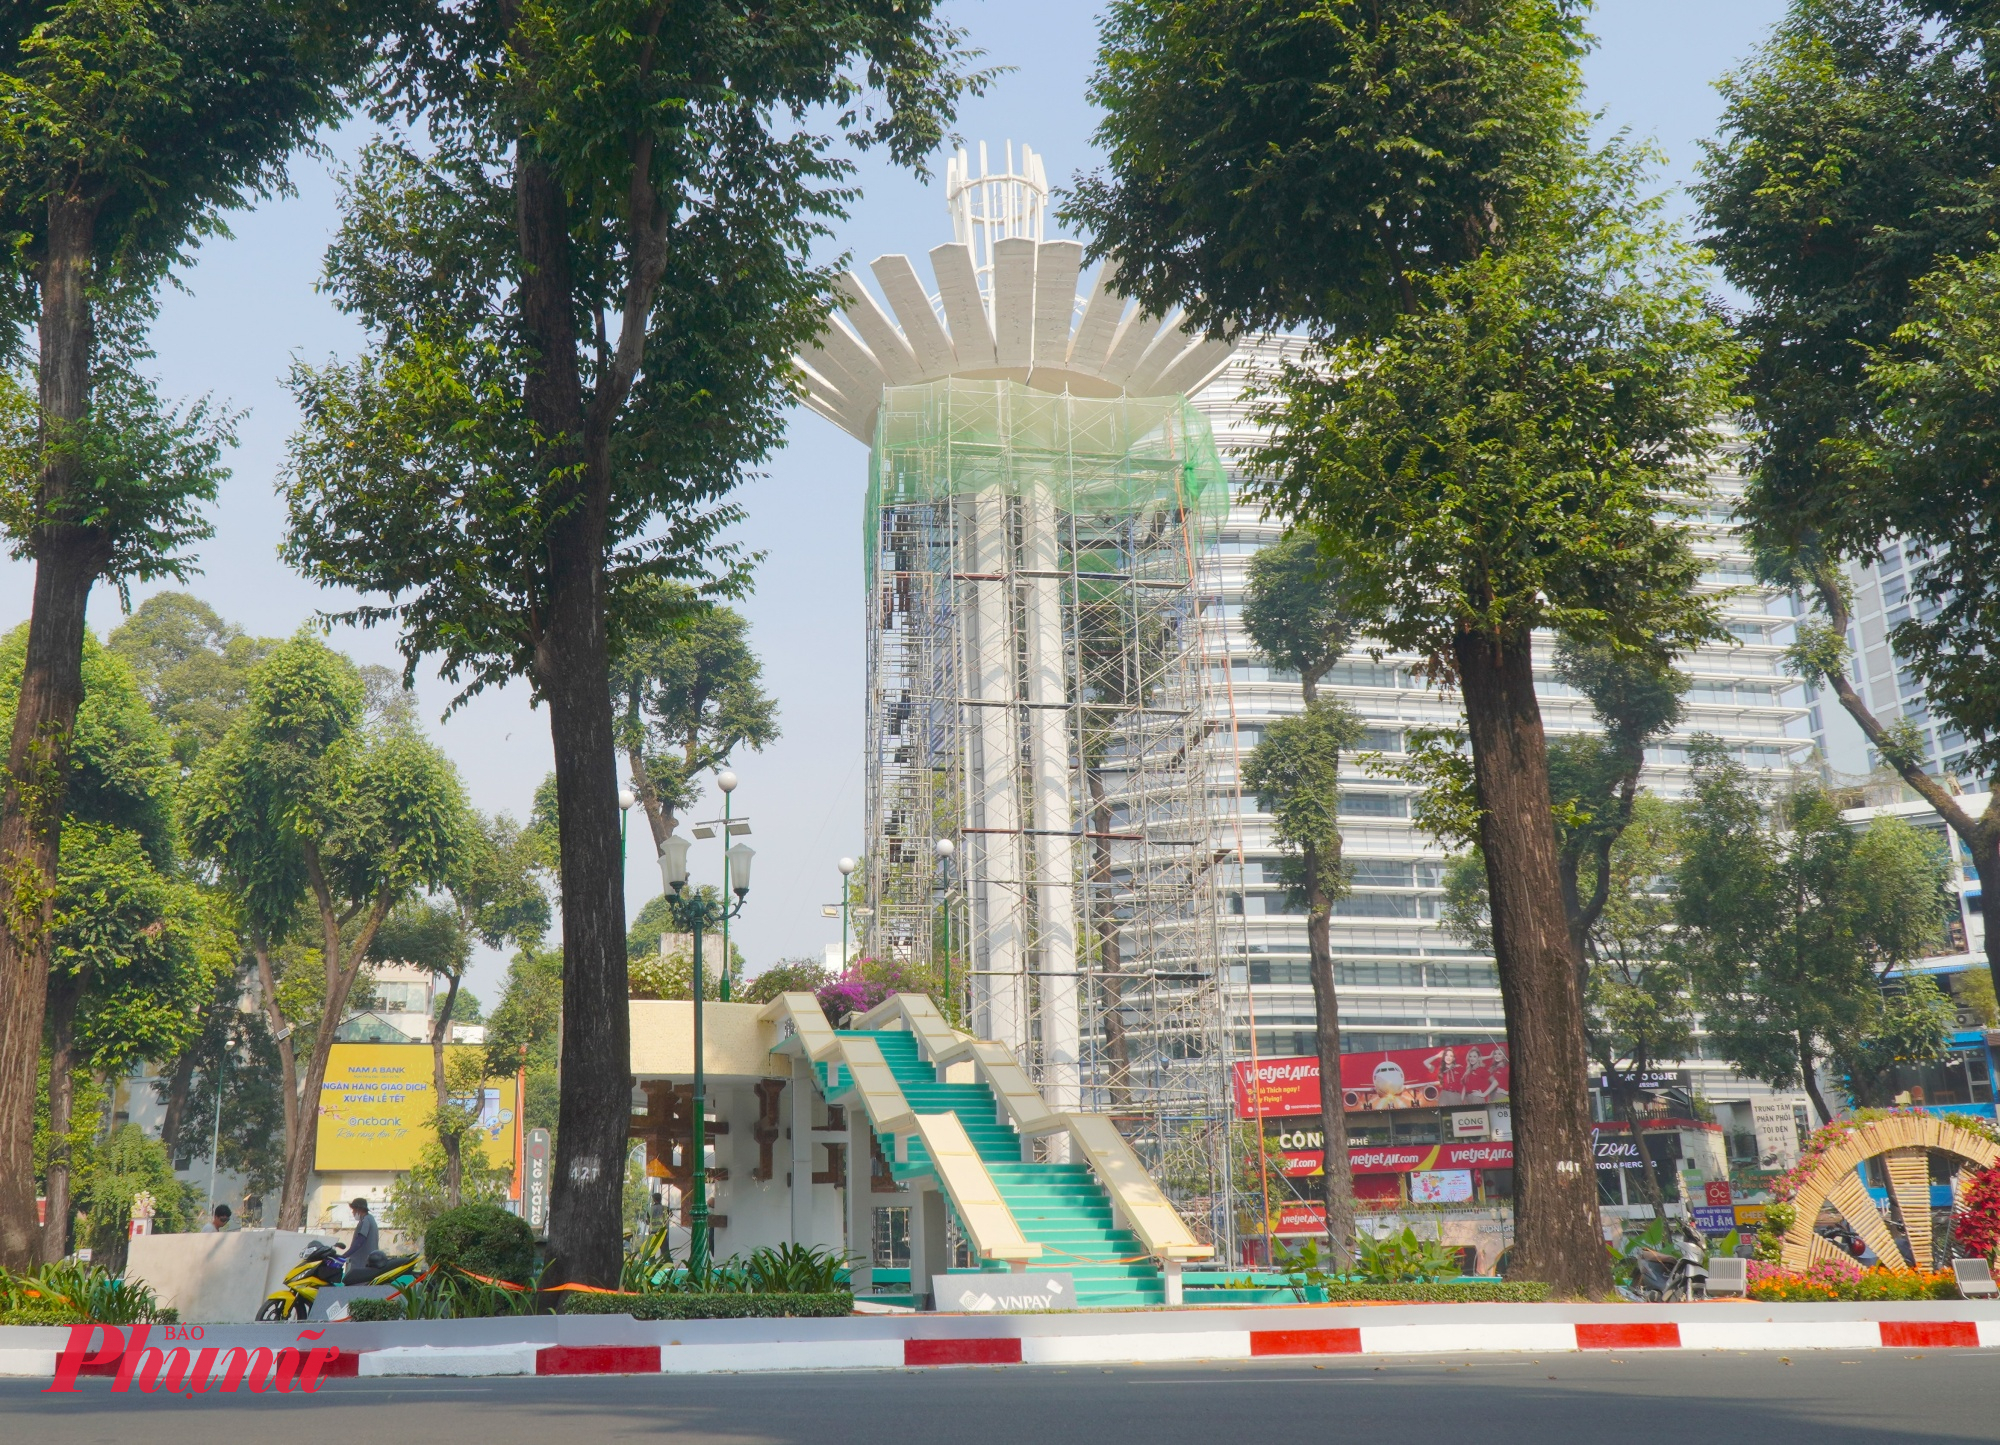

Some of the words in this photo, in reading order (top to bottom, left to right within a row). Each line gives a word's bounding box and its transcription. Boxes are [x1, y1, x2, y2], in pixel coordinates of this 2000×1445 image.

[348, 1066, 370, 1074] NAM
[379, 1066, 405, 1074] BANK
[1651, 1072, 1678, 1081] OBJET
[351, 1081, 379, 1092] HÀNG
[380, 1082, 403, 1091] GIAO
[405, 1082, 427, 1093] DỊCH
[343, 1093, 375, 1103] XUYÊN
[1754, 1104, 1776, 1113] TRUNG
[1776, 1103, 1791, 1111] TÂM
[1756, 1113, 1774, 1123] PHÂN
[531, 1131, 545, 1179] LONG
[1619, 1160, 1658, 1170] PIERCG
[997, 1295, 1053, 1310] VNPAY
